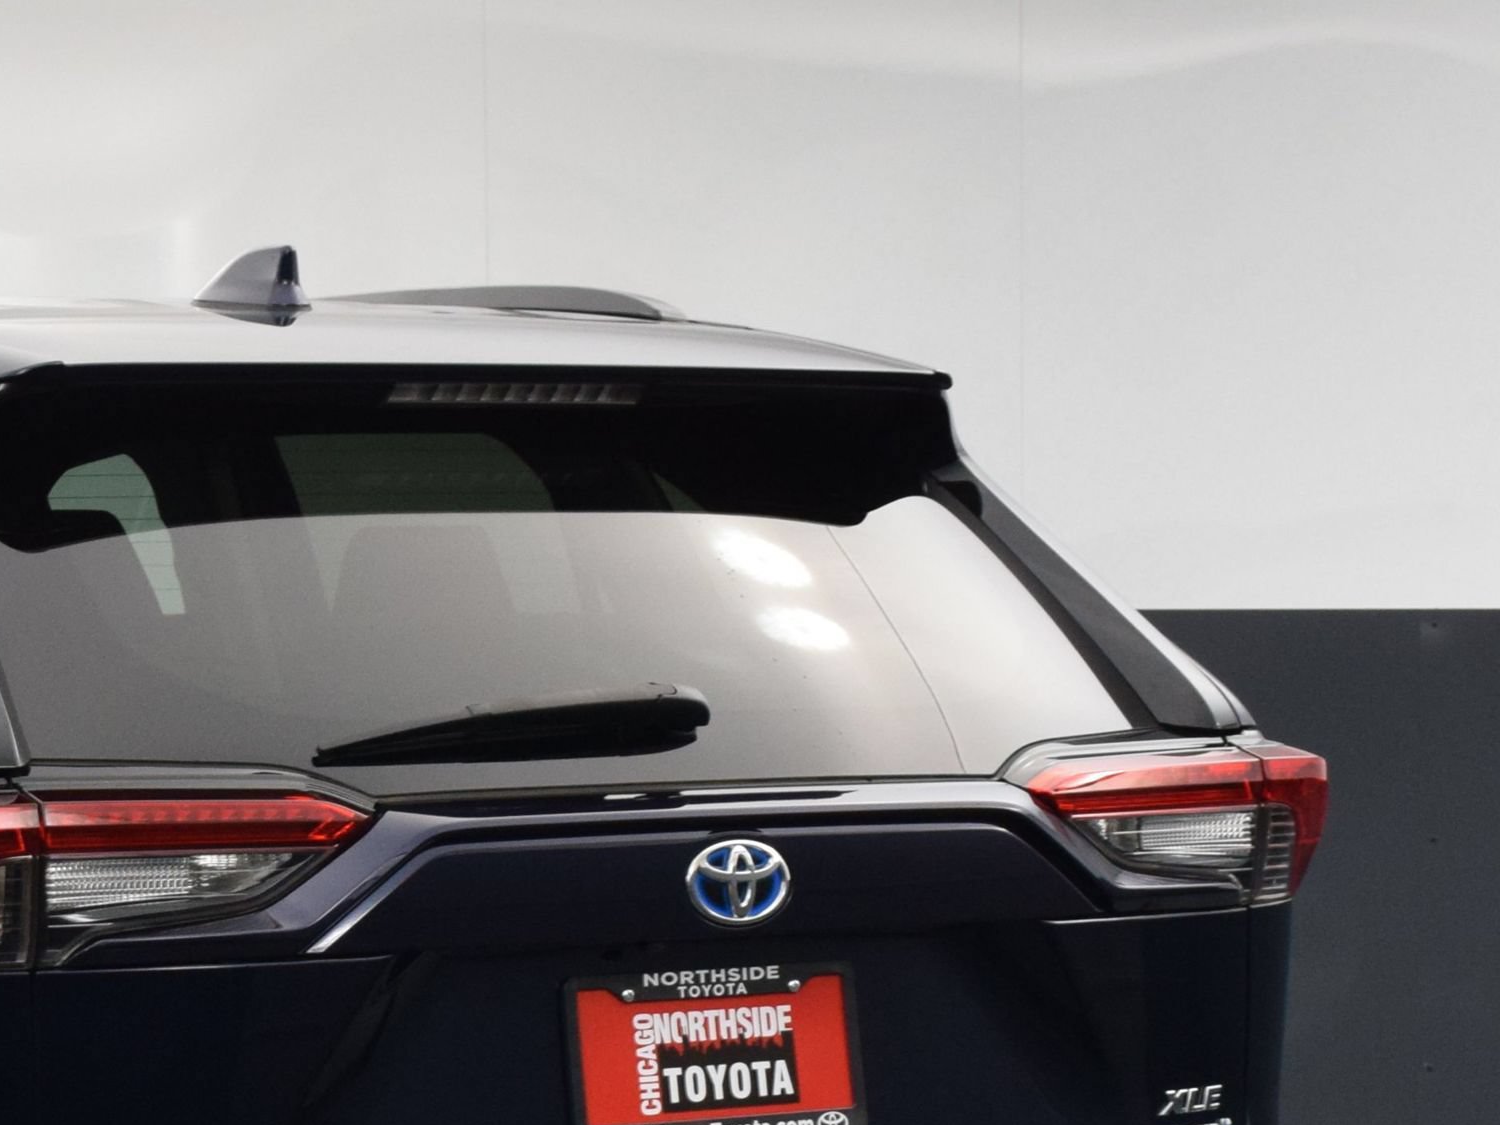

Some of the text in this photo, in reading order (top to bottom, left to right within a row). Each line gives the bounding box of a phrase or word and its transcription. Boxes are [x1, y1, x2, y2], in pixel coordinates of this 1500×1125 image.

[643, 965, 780, 987] NORTHSIDE
[677, 982, 748, 999] TOYOTA
[651, 1004, 793, 1044] NORTHSIDE
[632, 1013, 662, 1116] CHICAGO
[663, 1059, 794, 1104] TOYOTA
[1158, 1084, 1223, 1116] XLE
